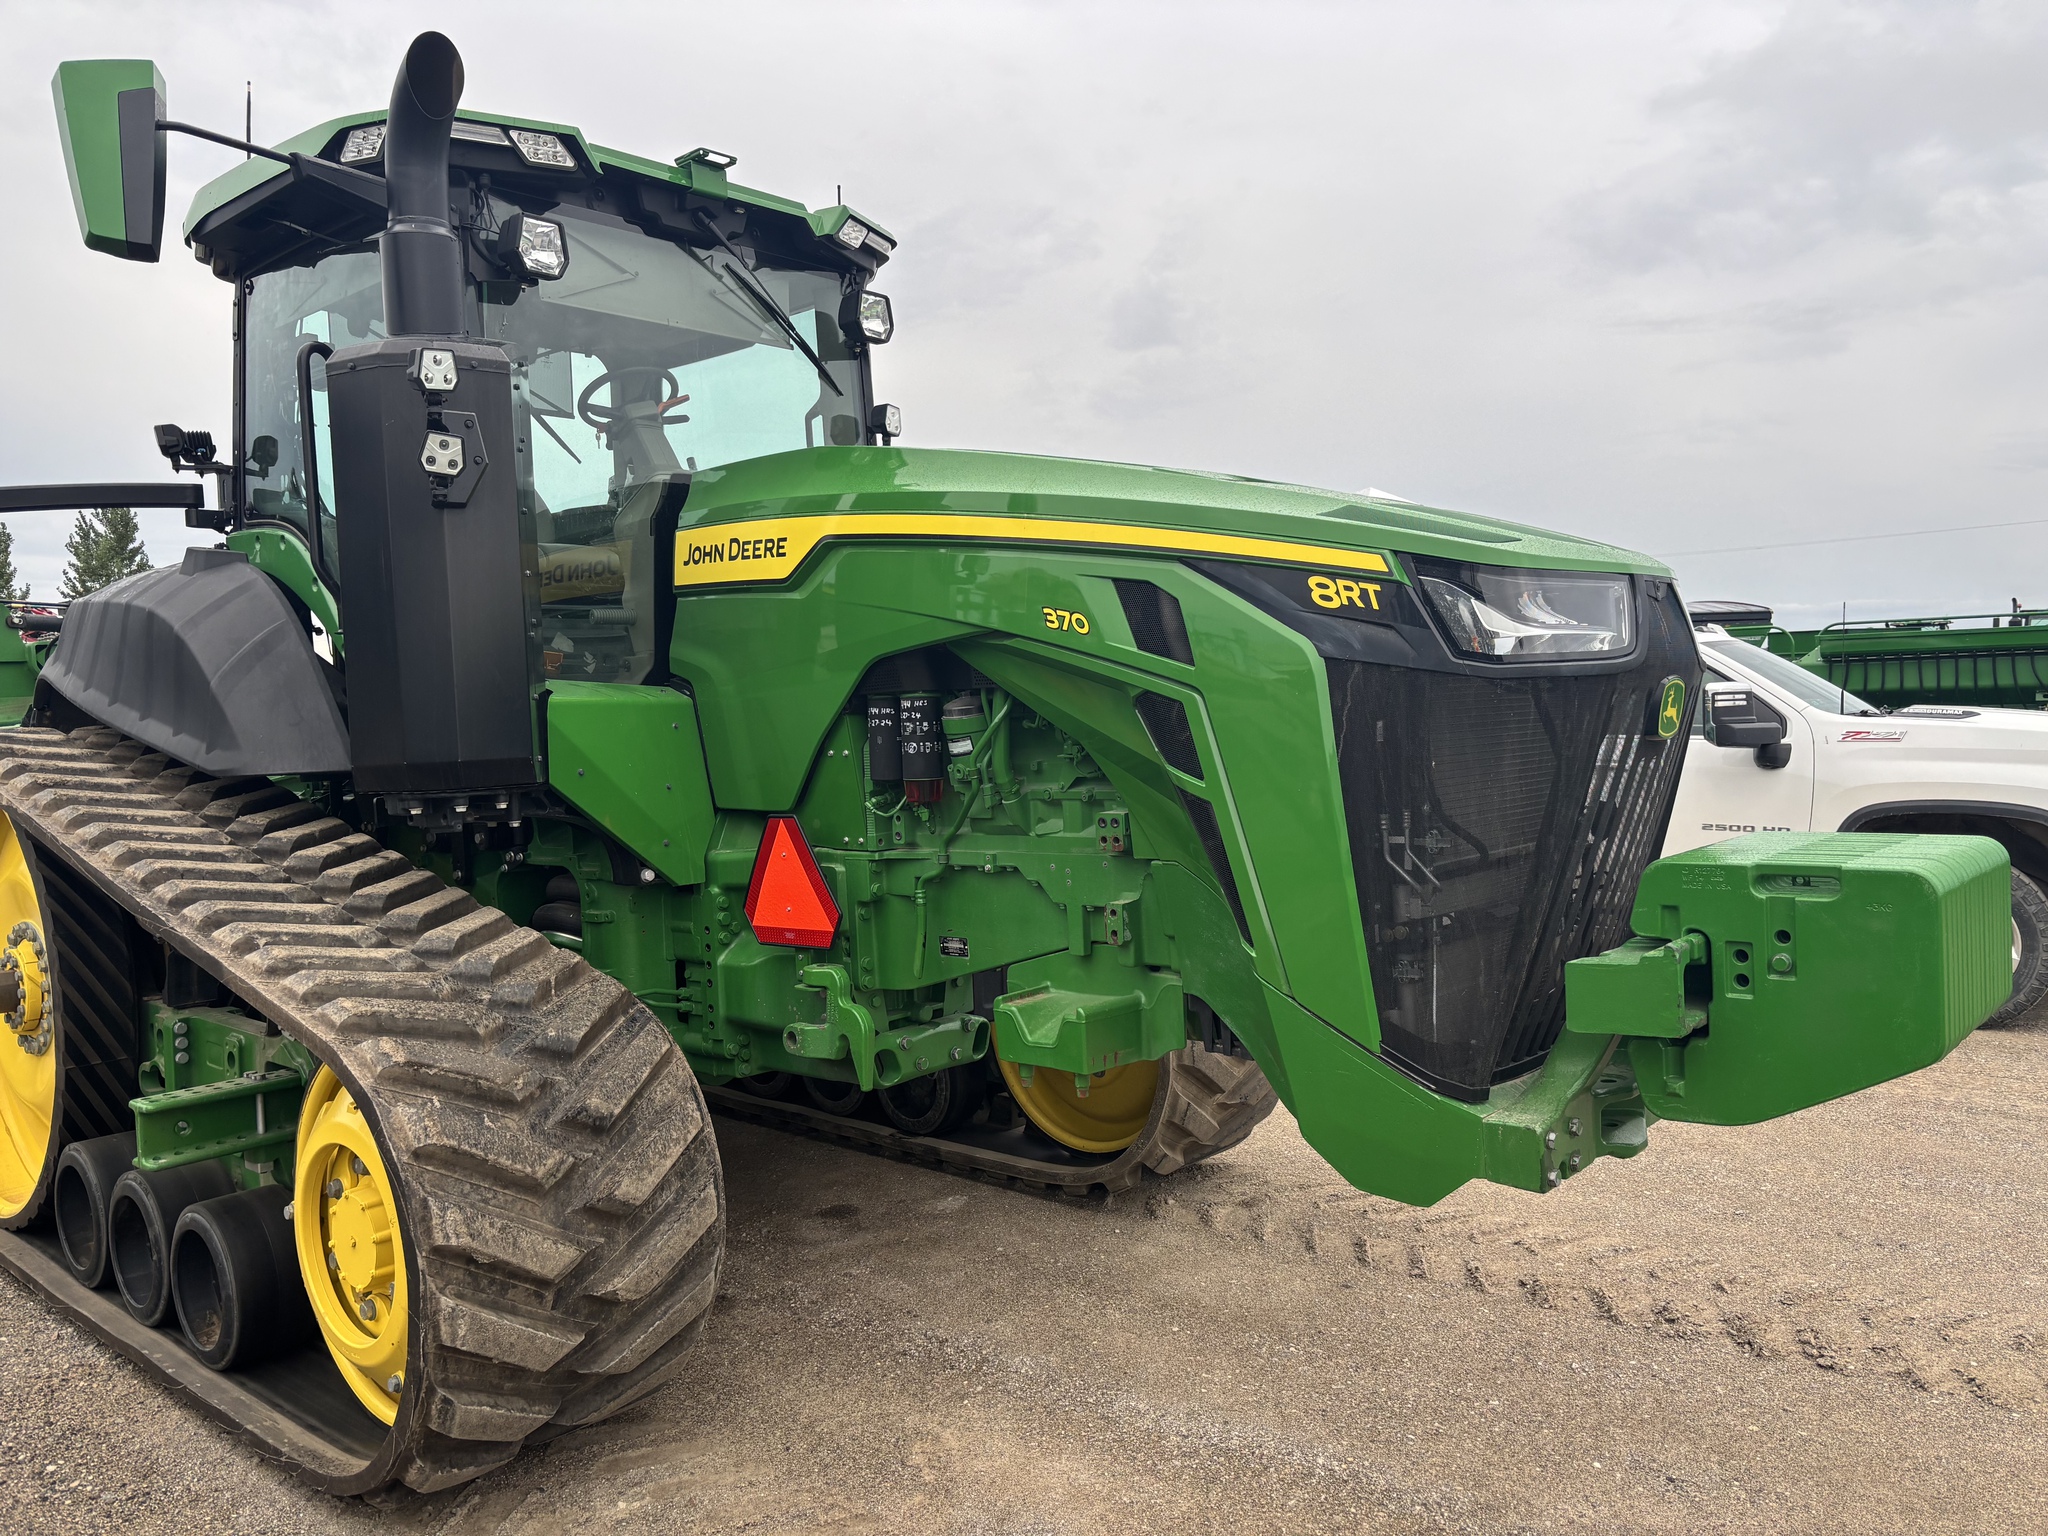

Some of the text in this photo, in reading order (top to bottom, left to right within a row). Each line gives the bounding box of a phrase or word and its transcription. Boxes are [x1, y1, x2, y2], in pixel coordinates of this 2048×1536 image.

[683, 537, 788, 567] JOHN DEERE
[1307, 575, 1382, 610] 8RT
[1042, 606, 1090, 635] 370
[1701, 823, 1755, 832] 2500
[1681, 882, 1702, 890] MADE
[1716, 883, 1732, 891] USA
